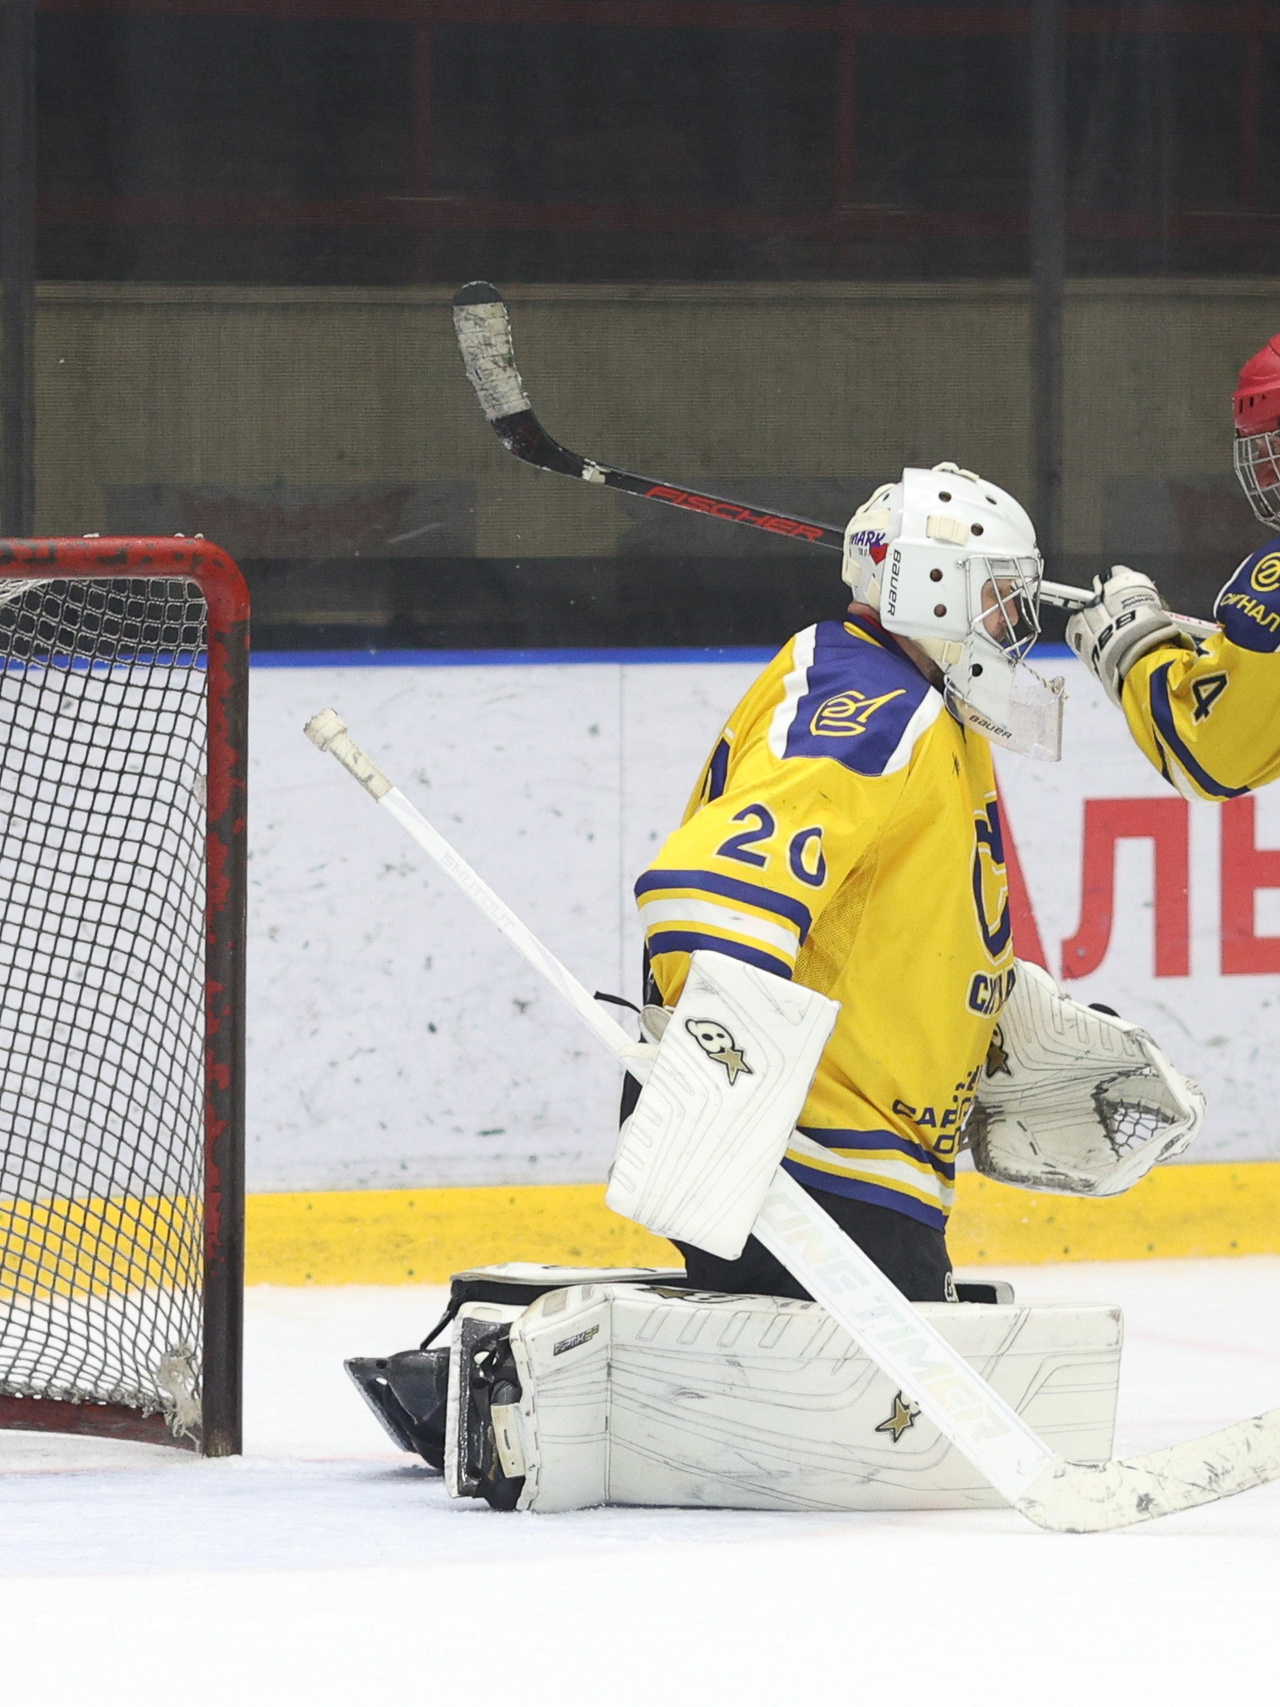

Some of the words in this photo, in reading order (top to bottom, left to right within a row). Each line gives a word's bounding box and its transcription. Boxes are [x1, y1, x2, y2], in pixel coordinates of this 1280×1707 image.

[645, 484, 825, 542] FISCHER
[887, 549, 902, 616] BAUER
[1191, 670, 1230, 724] 4
[969, 715, 1013, 739] BAUER
[715, 802, 829, 890] 20
